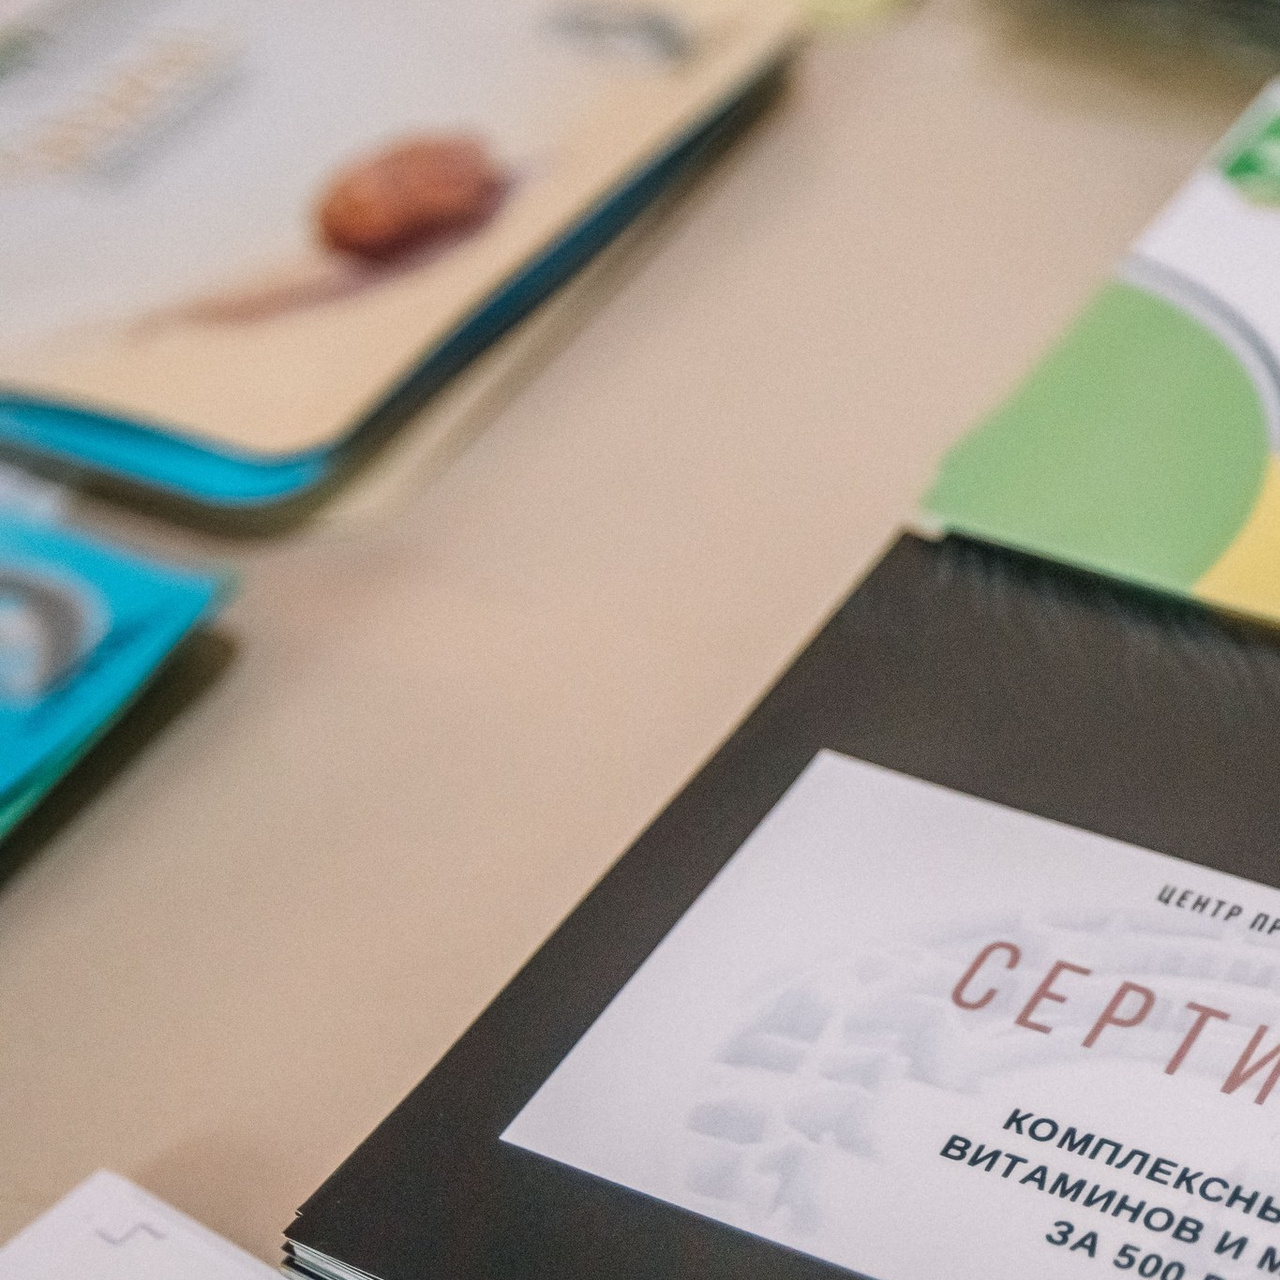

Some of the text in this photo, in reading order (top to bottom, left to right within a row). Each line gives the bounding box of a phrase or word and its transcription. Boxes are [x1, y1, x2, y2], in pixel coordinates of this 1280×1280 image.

[1156, 884, 1243, 921] ЦЕНТР
[939, 1134, 1204, 1245] ВИТАМИНОВ
[1213, 1230, 1249, 1261] И
[1045, 1220, 1100, 1258] ЗА
